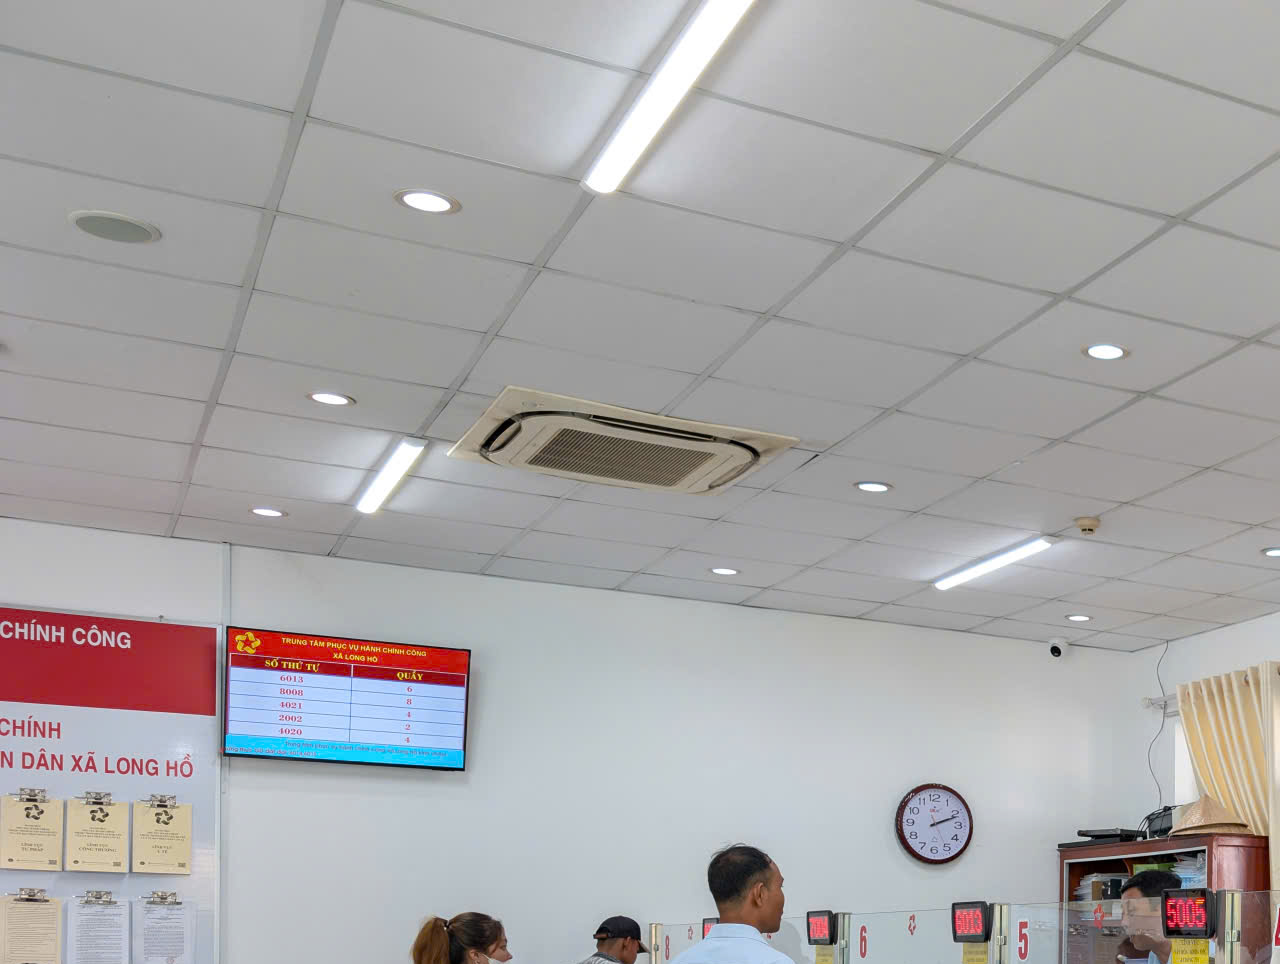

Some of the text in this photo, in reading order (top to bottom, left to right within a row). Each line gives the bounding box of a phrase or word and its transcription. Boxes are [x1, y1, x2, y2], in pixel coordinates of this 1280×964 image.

[0, 619, 132, 649] CHÍNH CÔNG
[282, 637, 308, 646] TRUNG
[309, 639, 325, 648] TÂM
[383, 647, 405, 655] CHÍNH
[406, 648, 427, 657] CÔNG
[345, 654, 366, 662] LONG
[265, 657, 279, 668] SỐ
[306, 663, 320, 673] TỰ
[280, 675, 304, 684] 6013
[280, 688, 304, 696] 8008
[280, 701, 302, 709] 4021
[279, 714, 303, 723] 2002
[0, 715, 61, 739] CHÍNH
[278, 727, 303, 736] 4020
[21, 748, 64, 771] DÂN
[71, 751, 98, 773] XÃ
[104, 756, 159, 777] LONG
[166, 753, 194, 778] HỒ
[918, 797, 926, 806] 11
[929, 794, 941, 803] 12
[909, 806, 920, 815] 10
[1166, 897, 1207, 928] 5005
[860, 925, 867, 958] 6
[1018, 921, 1029, 960] 5
[665, 935, 670, 960] 8
